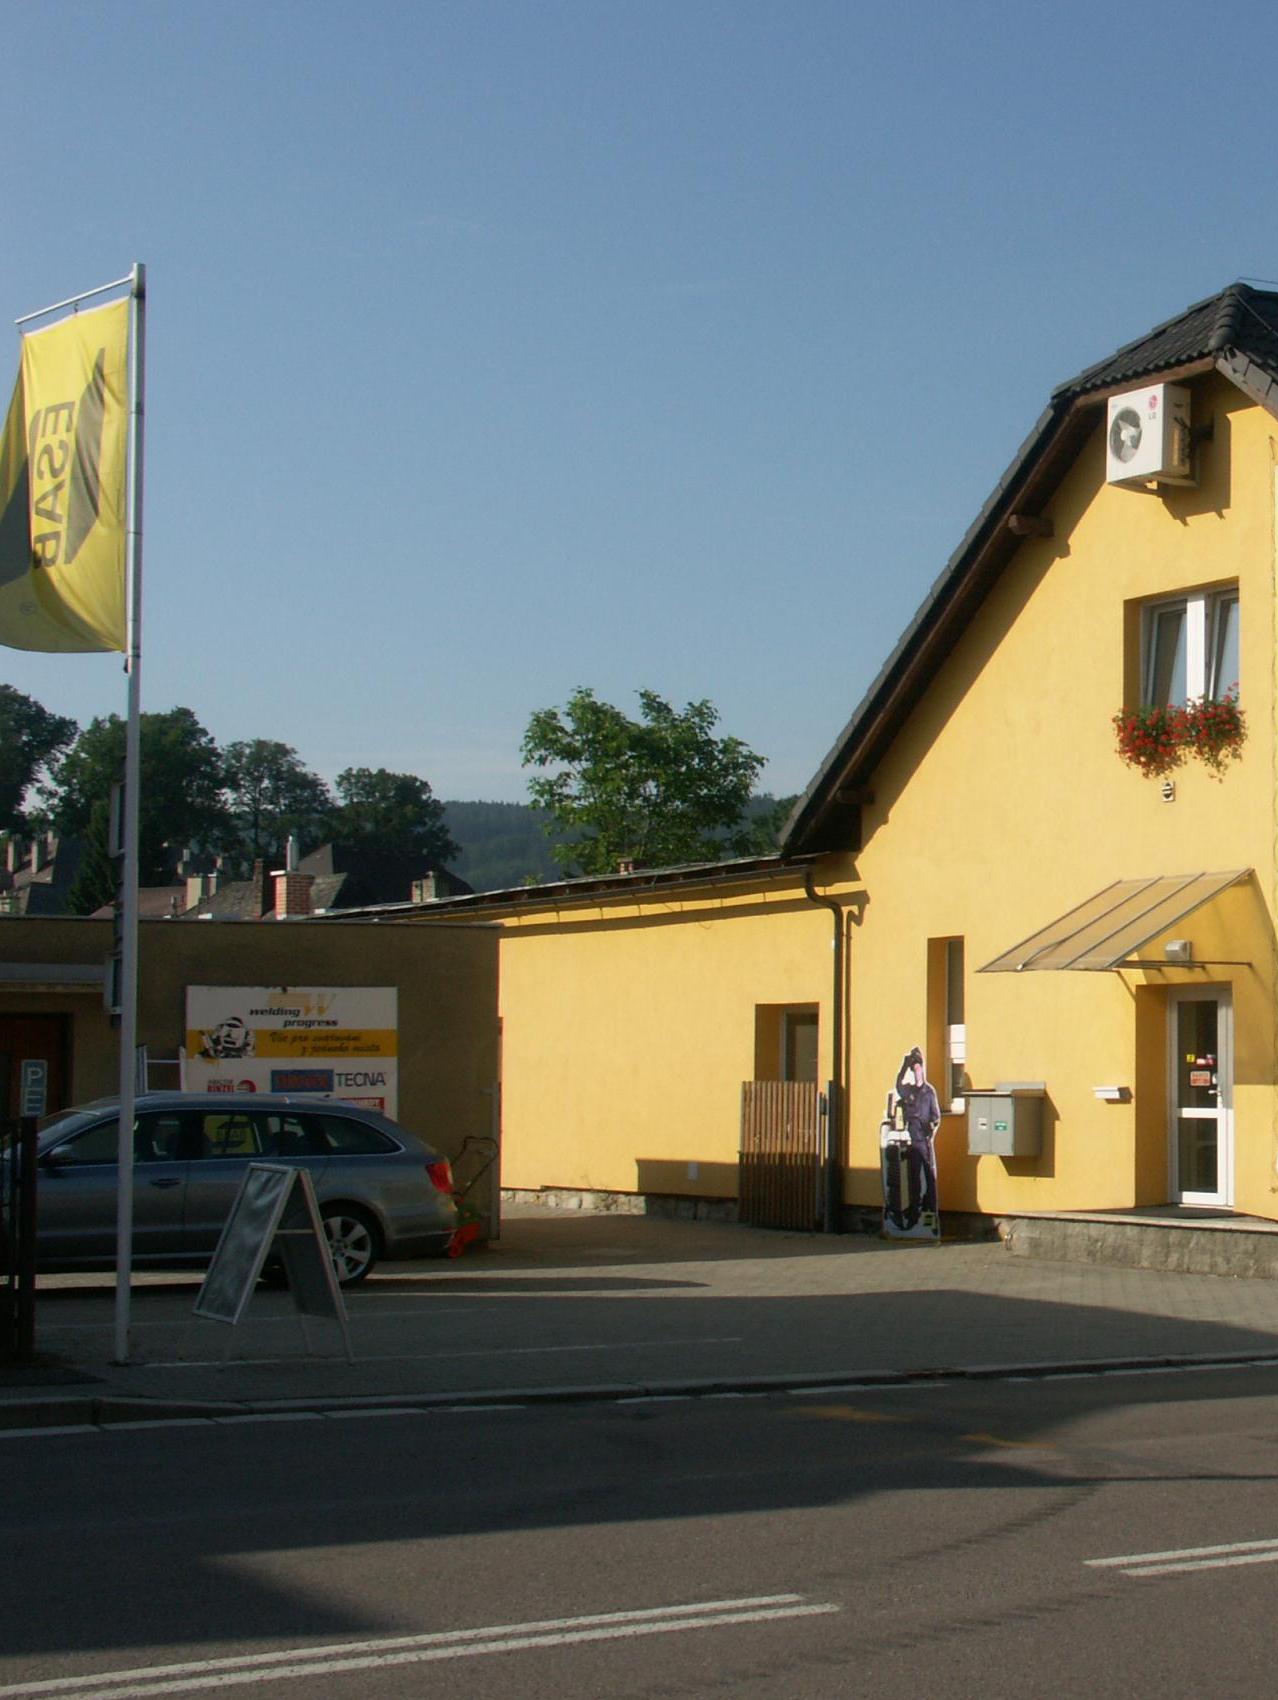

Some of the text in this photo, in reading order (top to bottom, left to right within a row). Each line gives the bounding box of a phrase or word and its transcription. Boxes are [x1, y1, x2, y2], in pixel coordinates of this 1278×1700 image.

[249, 1007, 301, 1018] welding
[283, 1019, 338, 1029] progress
[27, 1067, 43, 1086] P
[335, 1072, 387, 1088] TECNA
